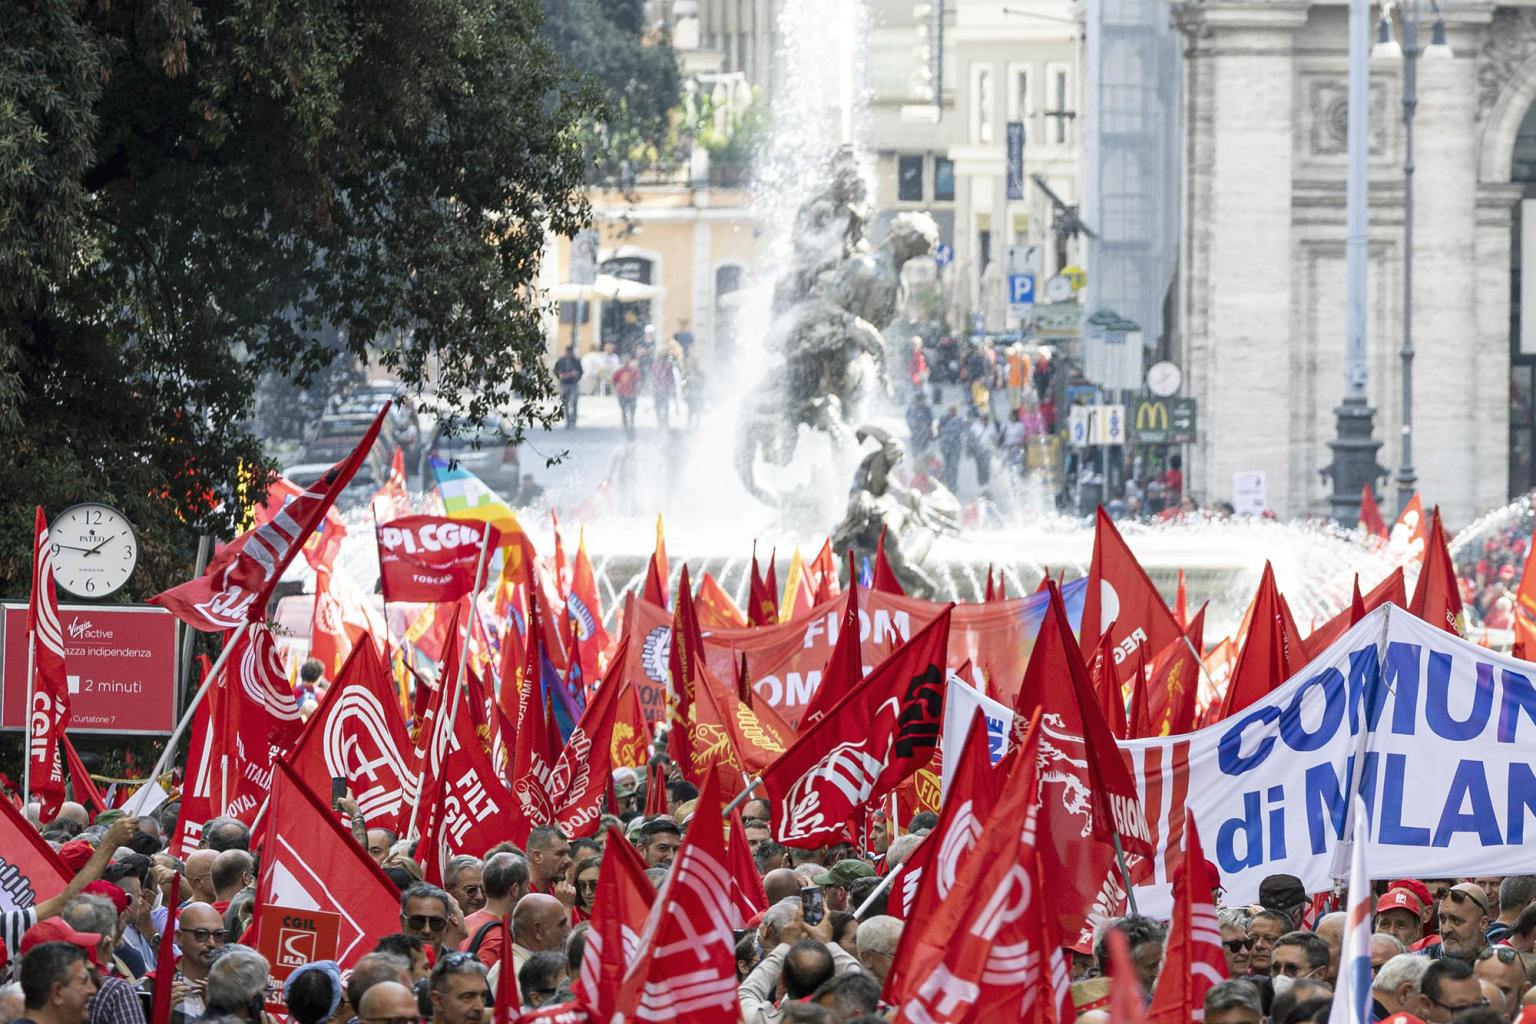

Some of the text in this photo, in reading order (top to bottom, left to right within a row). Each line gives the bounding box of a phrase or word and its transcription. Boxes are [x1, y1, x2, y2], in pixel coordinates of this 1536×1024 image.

[85, 511, 102, 525] 12
[79, 535, 105, 543] PATEO
[51, 543, 61, 558] 9
[124, 545, 132, 560] 3
[85, 578, 95, 593] 6
[67, 616, 93, 639] Virgin
[84, 629, 114, 639] active
[803, 609, 911, 649] FIOM
[64, 647, 152, 659] azza indipendenza
[85, 680, 142, 694] 2 minuti
[31, 690, 52, 762] CGIL
[73, 715, 116, 724] Curtatone 7
[455, 767, 500, 823] FILT
[921, 782, 942, 811] FIO
[1216, 785, 1288, 874] di
[282, 916, 317, 931] CGIL
